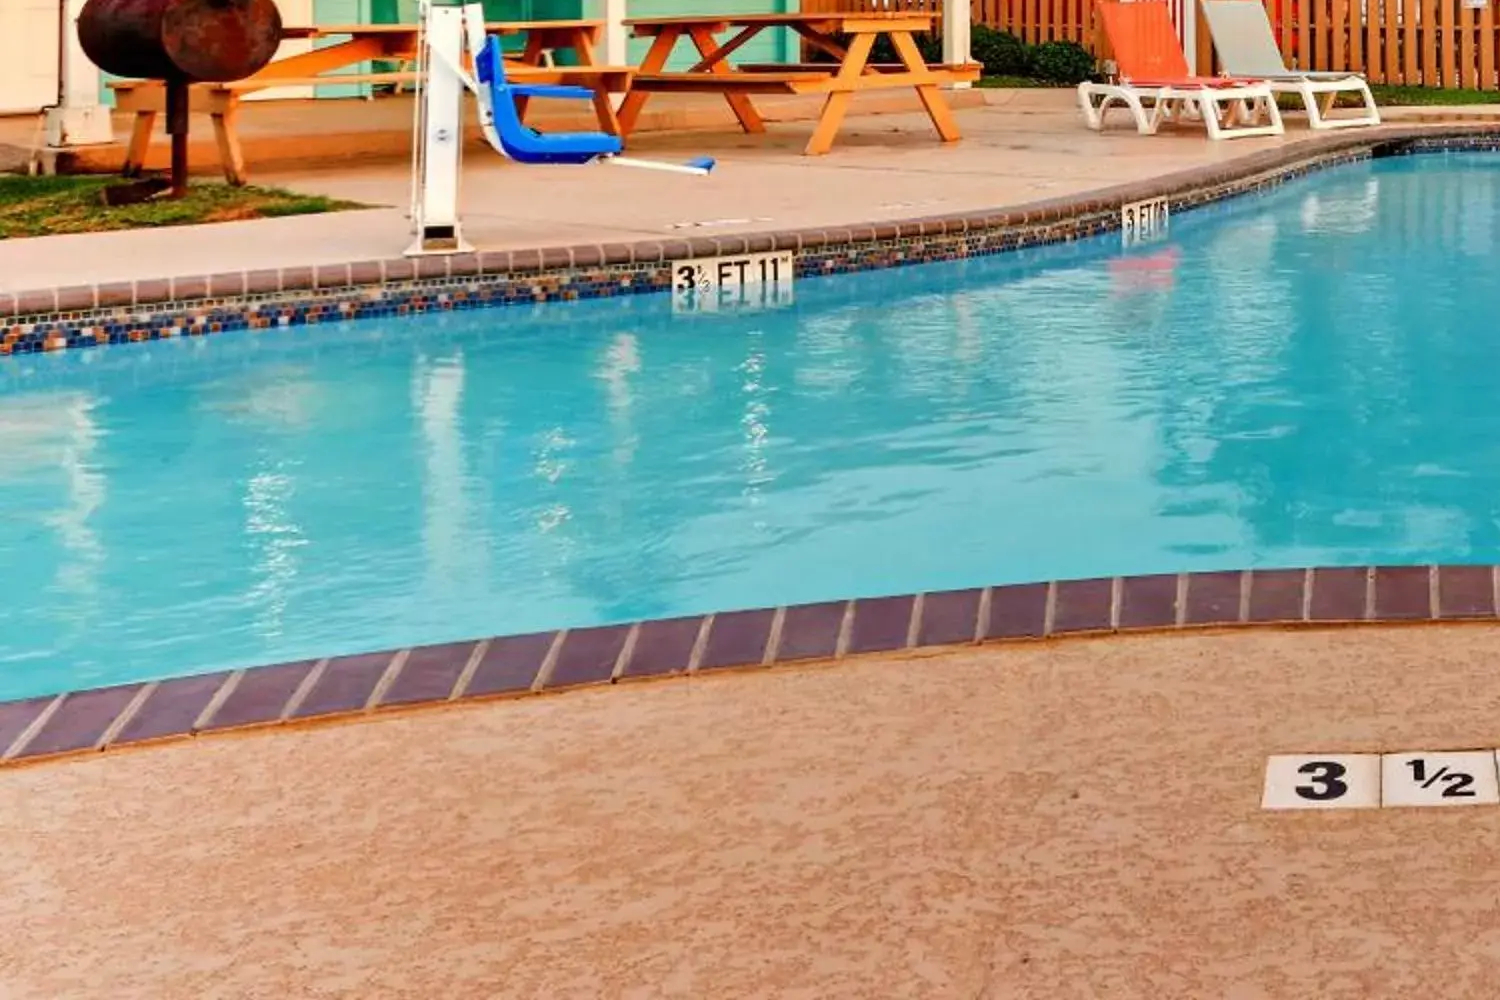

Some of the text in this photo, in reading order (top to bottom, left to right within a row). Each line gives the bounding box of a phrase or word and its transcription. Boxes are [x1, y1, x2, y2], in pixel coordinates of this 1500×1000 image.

[677, 266, 695, 289] 3
[717, 261, 750, 286] FT
[759, 257, 779, 281] 11
[1295, 761, 1348, 800] 3
